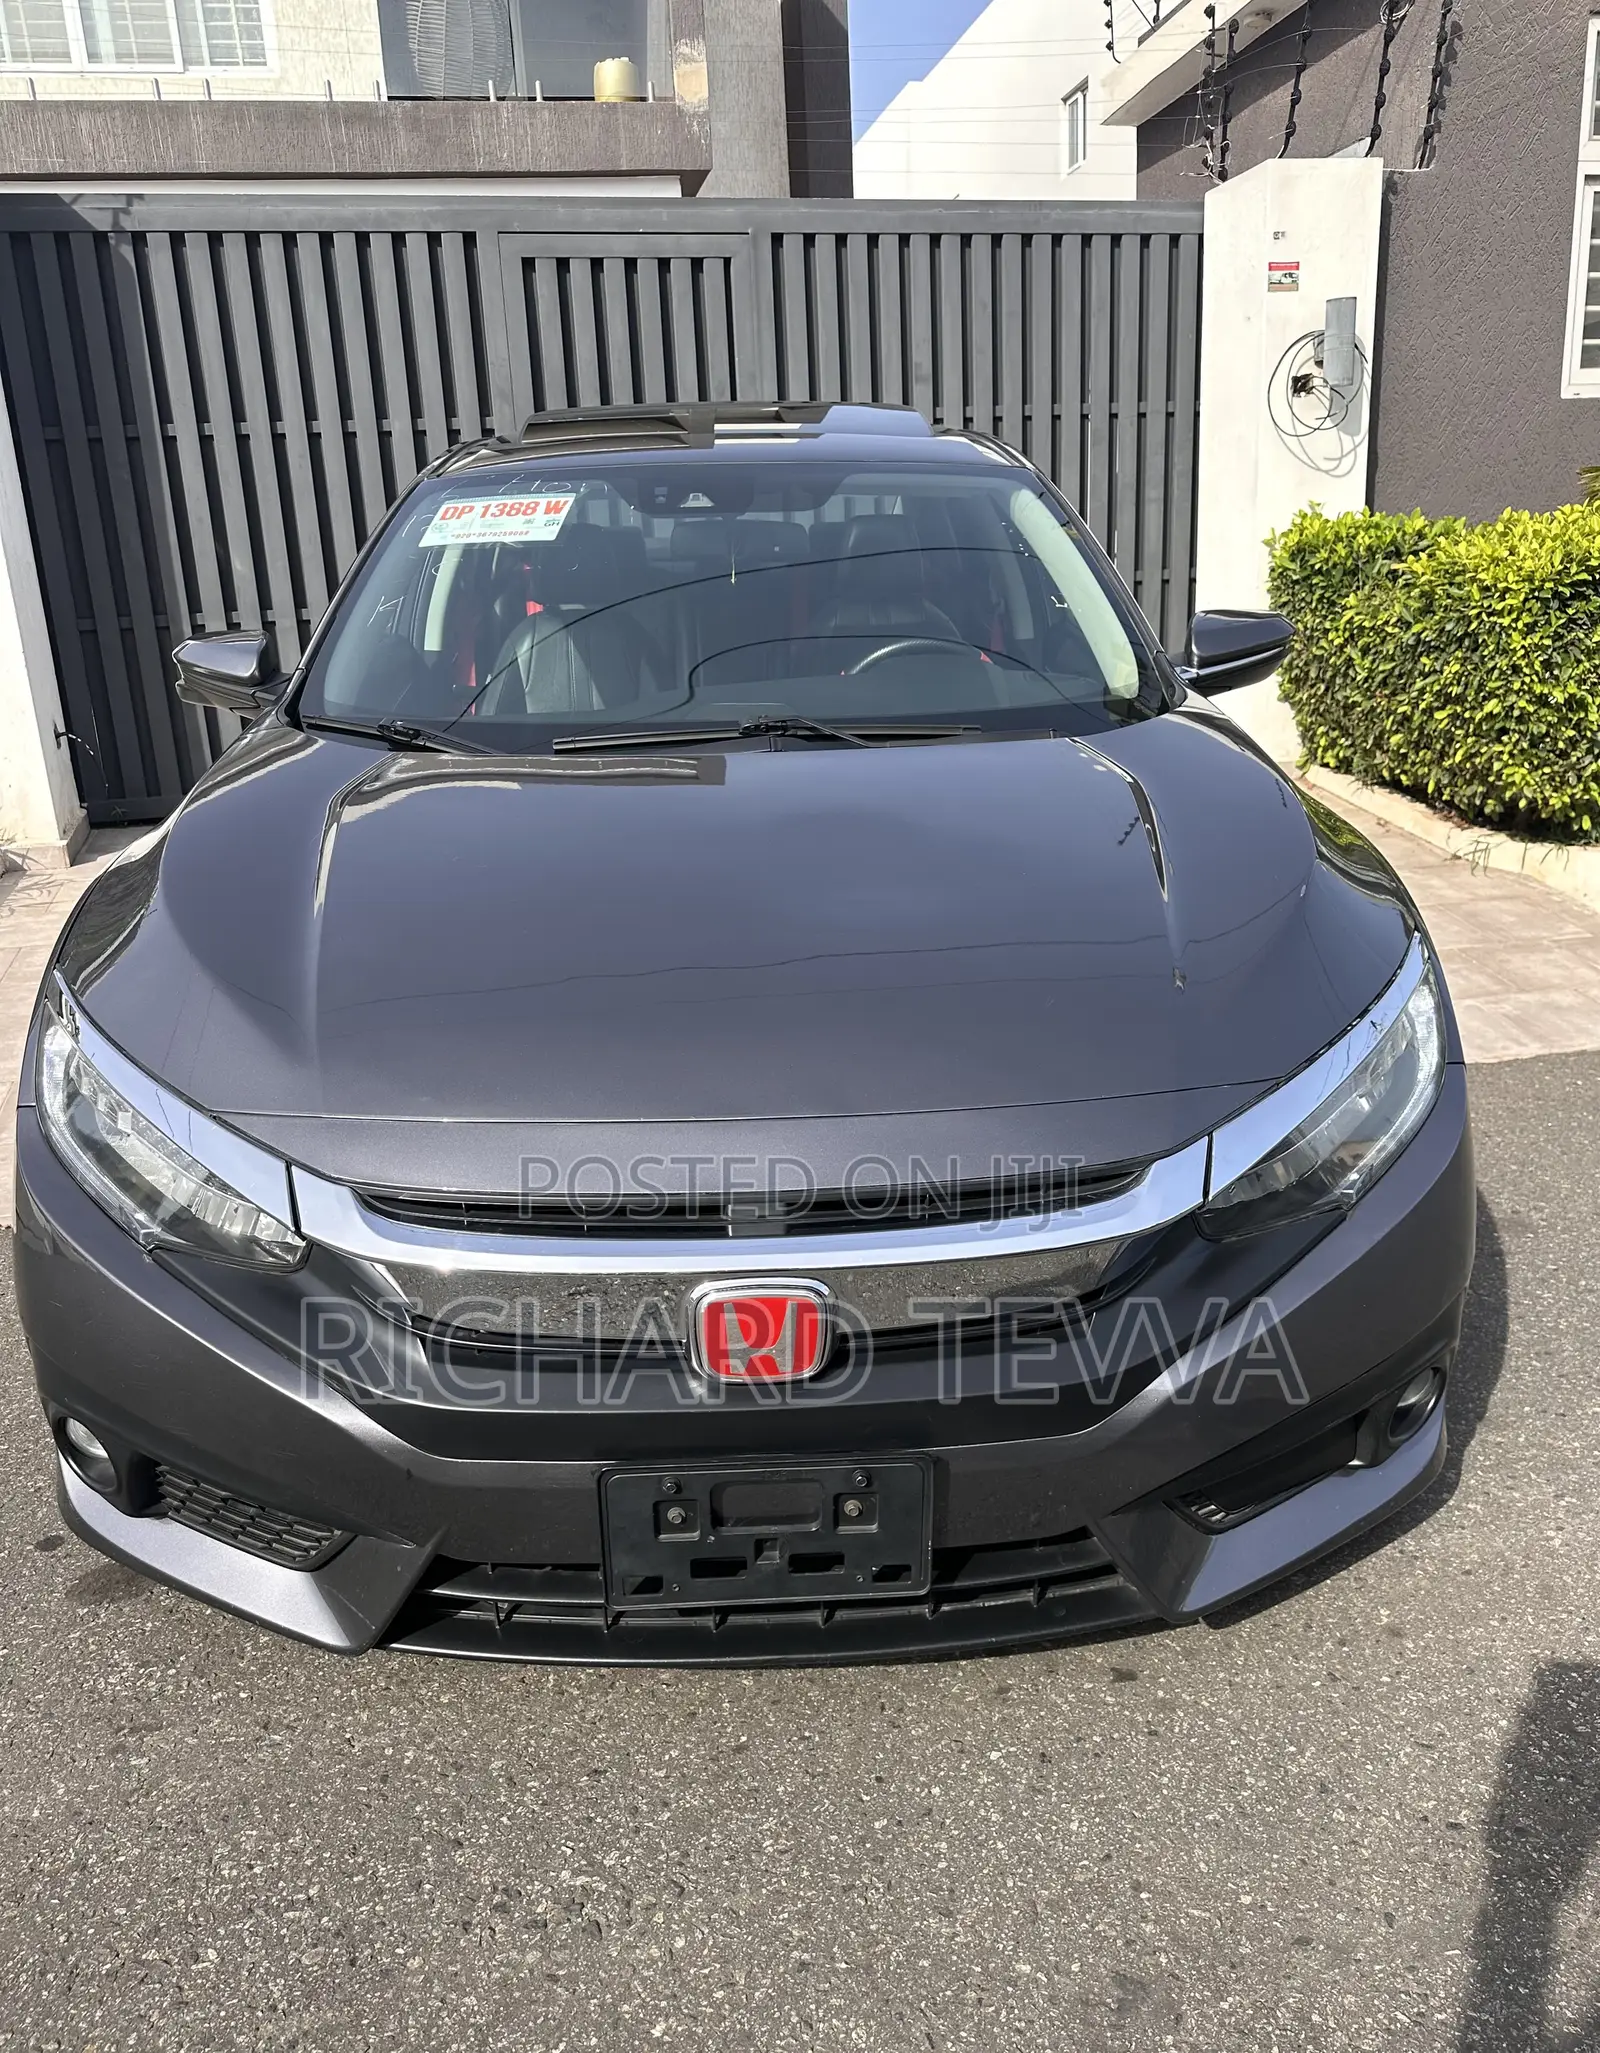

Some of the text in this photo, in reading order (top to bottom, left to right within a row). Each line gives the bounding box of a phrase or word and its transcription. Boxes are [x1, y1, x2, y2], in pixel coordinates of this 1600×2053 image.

[440, 500, 568, 520] DP 1388 W
